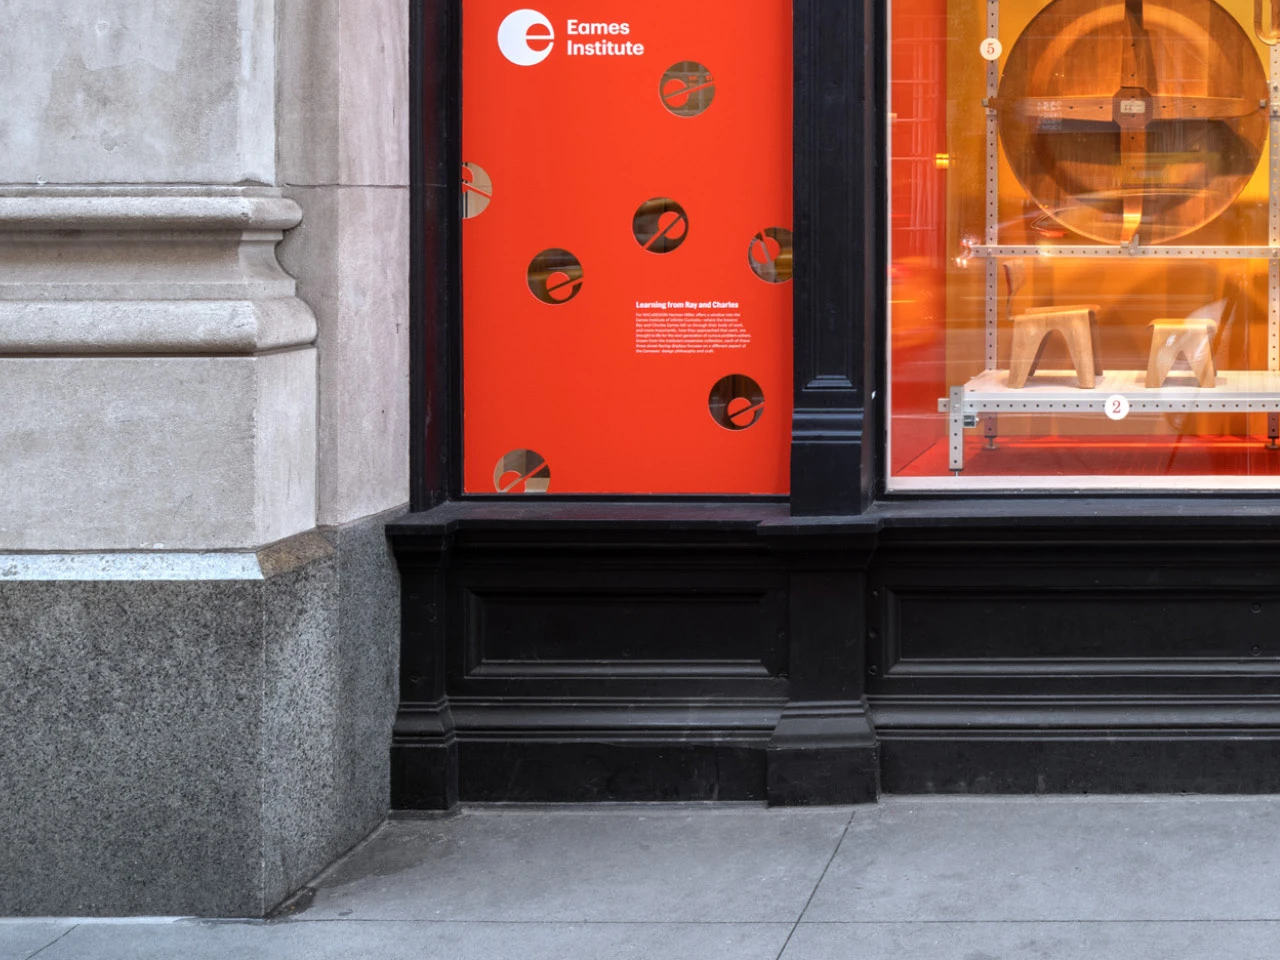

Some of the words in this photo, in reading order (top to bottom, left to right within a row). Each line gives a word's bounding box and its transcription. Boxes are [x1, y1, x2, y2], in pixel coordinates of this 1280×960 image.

[567, 19, 630, 35] Eames
[567, 40, 645, 56] Institute
[636, 301, 666, 309] Learning
[685, 301, 697, 309] Ray
